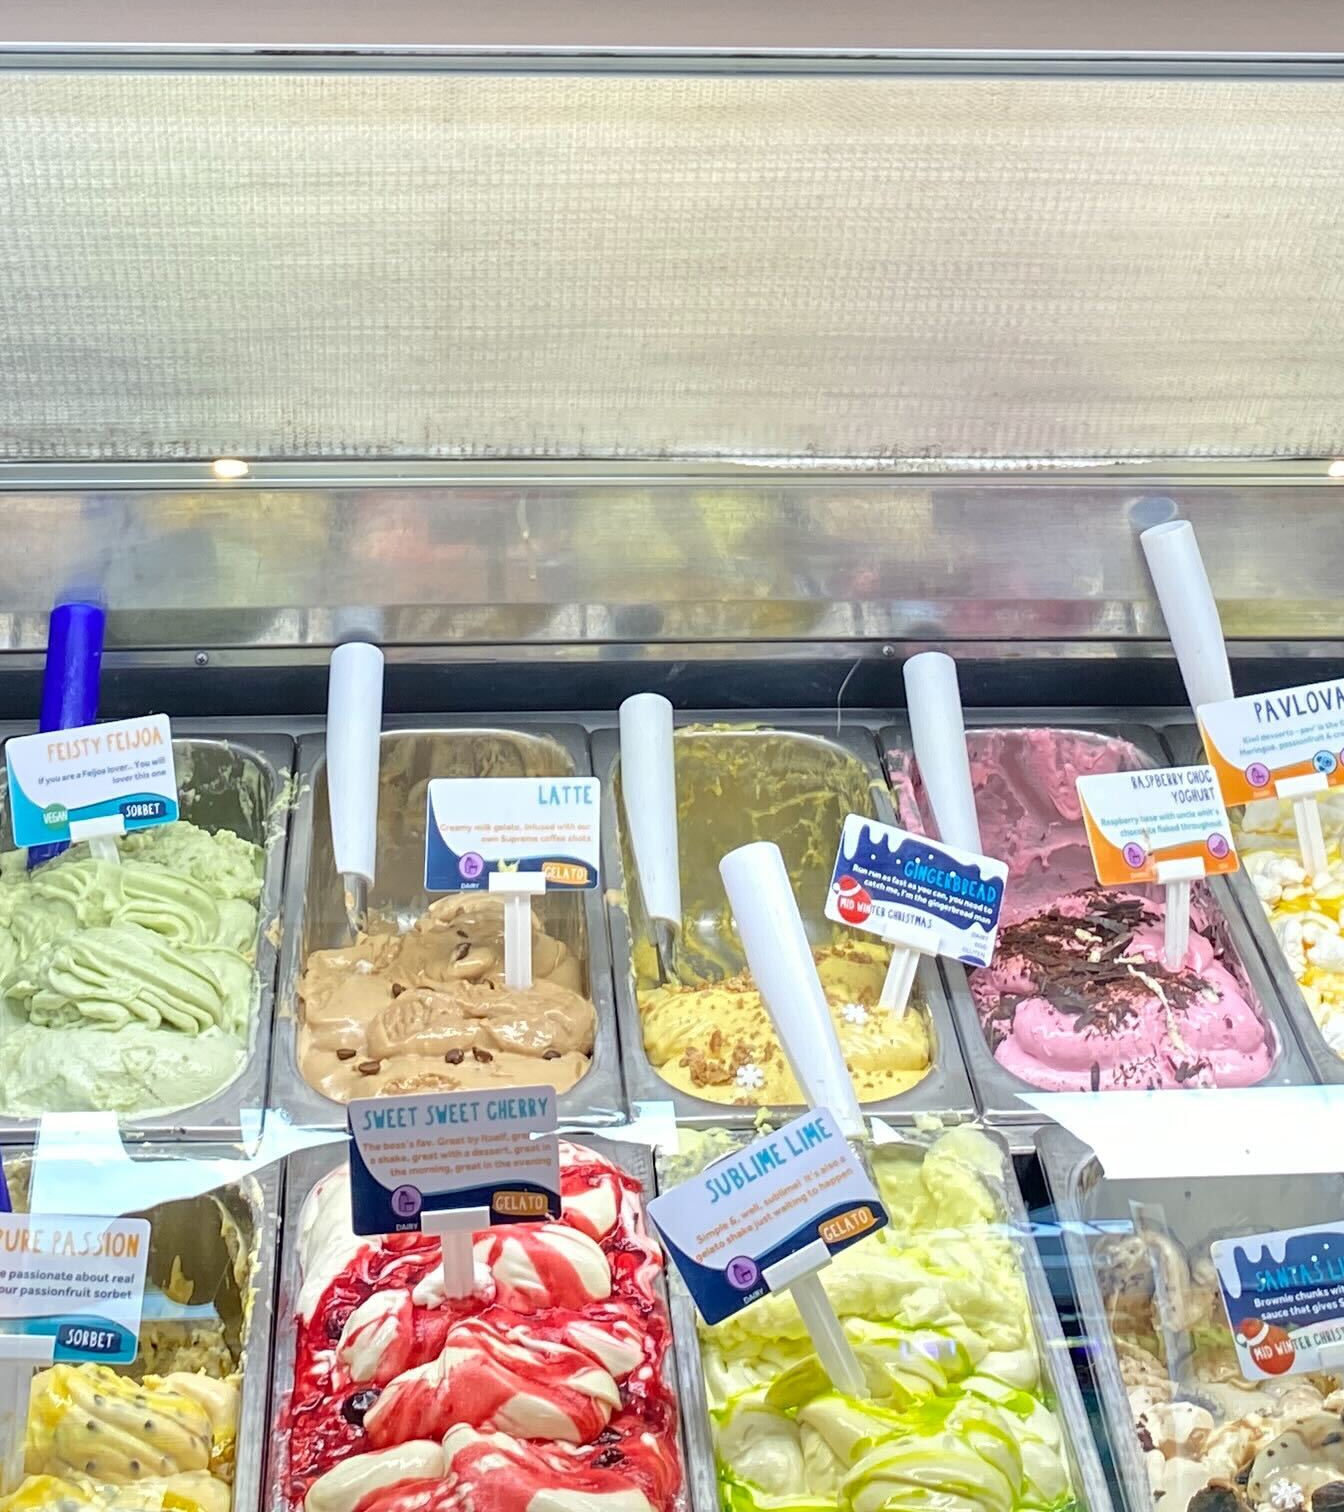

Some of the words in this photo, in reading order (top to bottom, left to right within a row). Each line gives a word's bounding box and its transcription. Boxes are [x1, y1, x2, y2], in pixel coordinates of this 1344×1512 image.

[47, 739, 101, 763] FEISTY
[108, 727, 163, 752] FEIJOA
[1131, 772, 1184, 789] RASPBERRY
[1187, 769, 1213, 784] CHOC
[538, 785, 593, 805] LATTE
[1171, 787, 1217, 804] YOGHURT
[125, 803, 161, 818] SORBET
[363, 1106, 417, 1131] SWEET
[425, 1101, 480, 1126] SWEET
[486, 1096, 548, 1121] CHERRY
[705, 1143, 787, 1203] SUBLIME
[784, 1116, 833, 1157] LIME
[495, 1195, 545, 1212] GELATO
[822, 1209, 870, 1242] GELATO
[51, 1230, 140, 1258] PASSION
[8, 1269, 73, 1282] passionate
[74, 1272, 109, 1283] about
[111, 1273, 135, 1283] real
[19, 1284, 91, 1298] passionfruit
[94, 1289, 132, 1299] sorbet
[1254, 1295, 1294, 1308] Brownie
[65, 1328, 114, 1349] SORBET
